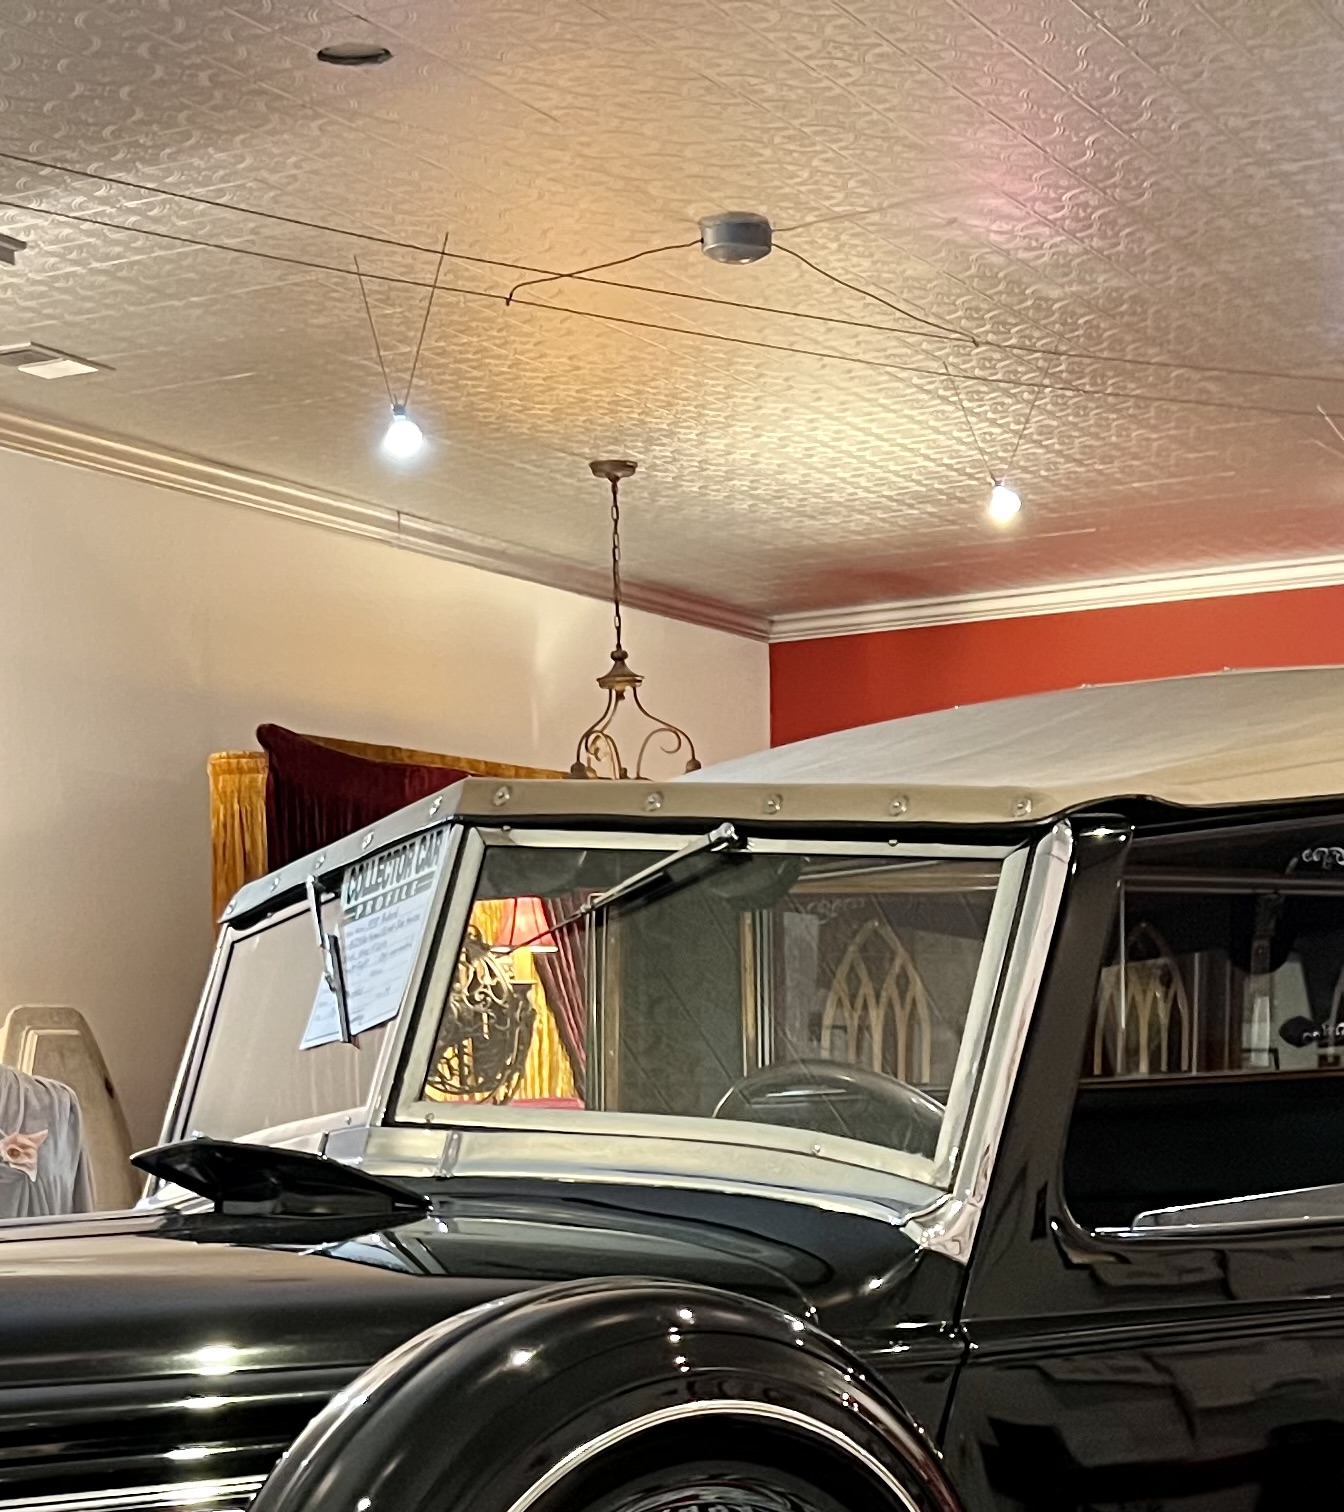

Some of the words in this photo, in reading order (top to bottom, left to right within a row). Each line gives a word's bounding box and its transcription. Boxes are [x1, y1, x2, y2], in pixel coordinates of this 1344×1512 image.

[346, 841, 416, 905] COLLECTOR
[416, 829, 444, 875] CAR
[355, 880, 418, 920] PROFILE
